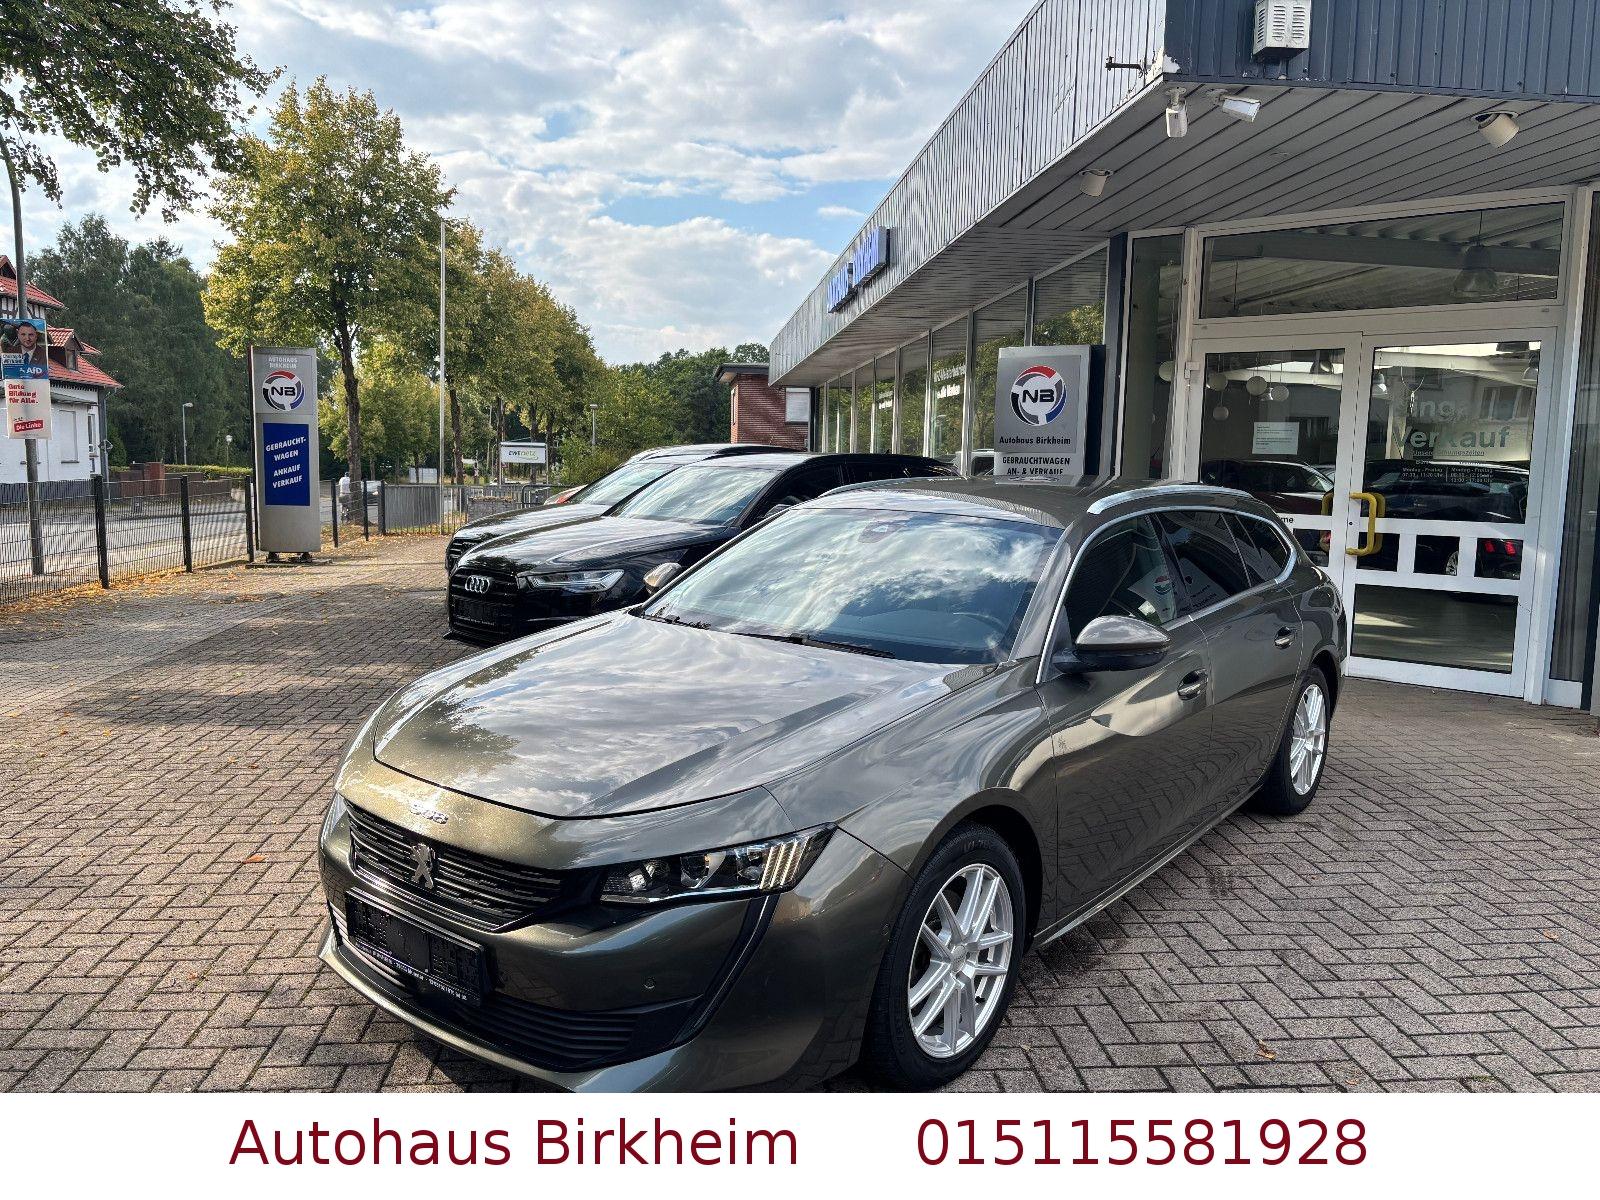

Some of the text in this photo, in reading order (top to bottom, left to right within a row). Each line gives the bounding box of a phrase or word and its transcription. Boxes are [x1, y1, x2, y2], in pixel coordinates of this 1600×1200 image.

[26, 367, 42, 375] AfD
[270, 386, 296, 396] NB
[1022, 389, 1055, 403] NB
[265, 436, 307, 452] GEBRAUCHT-
[999, 436, 1071, 444] Autohaus Birkheim
[273, 449, 299, 461] WAGEN
[1002, 456, 1071, 466] GEBRAUCHTWAGEN
[273, 464, 301, 477] ANKAUF
[272, 475, 303, 489] VERKAUF
